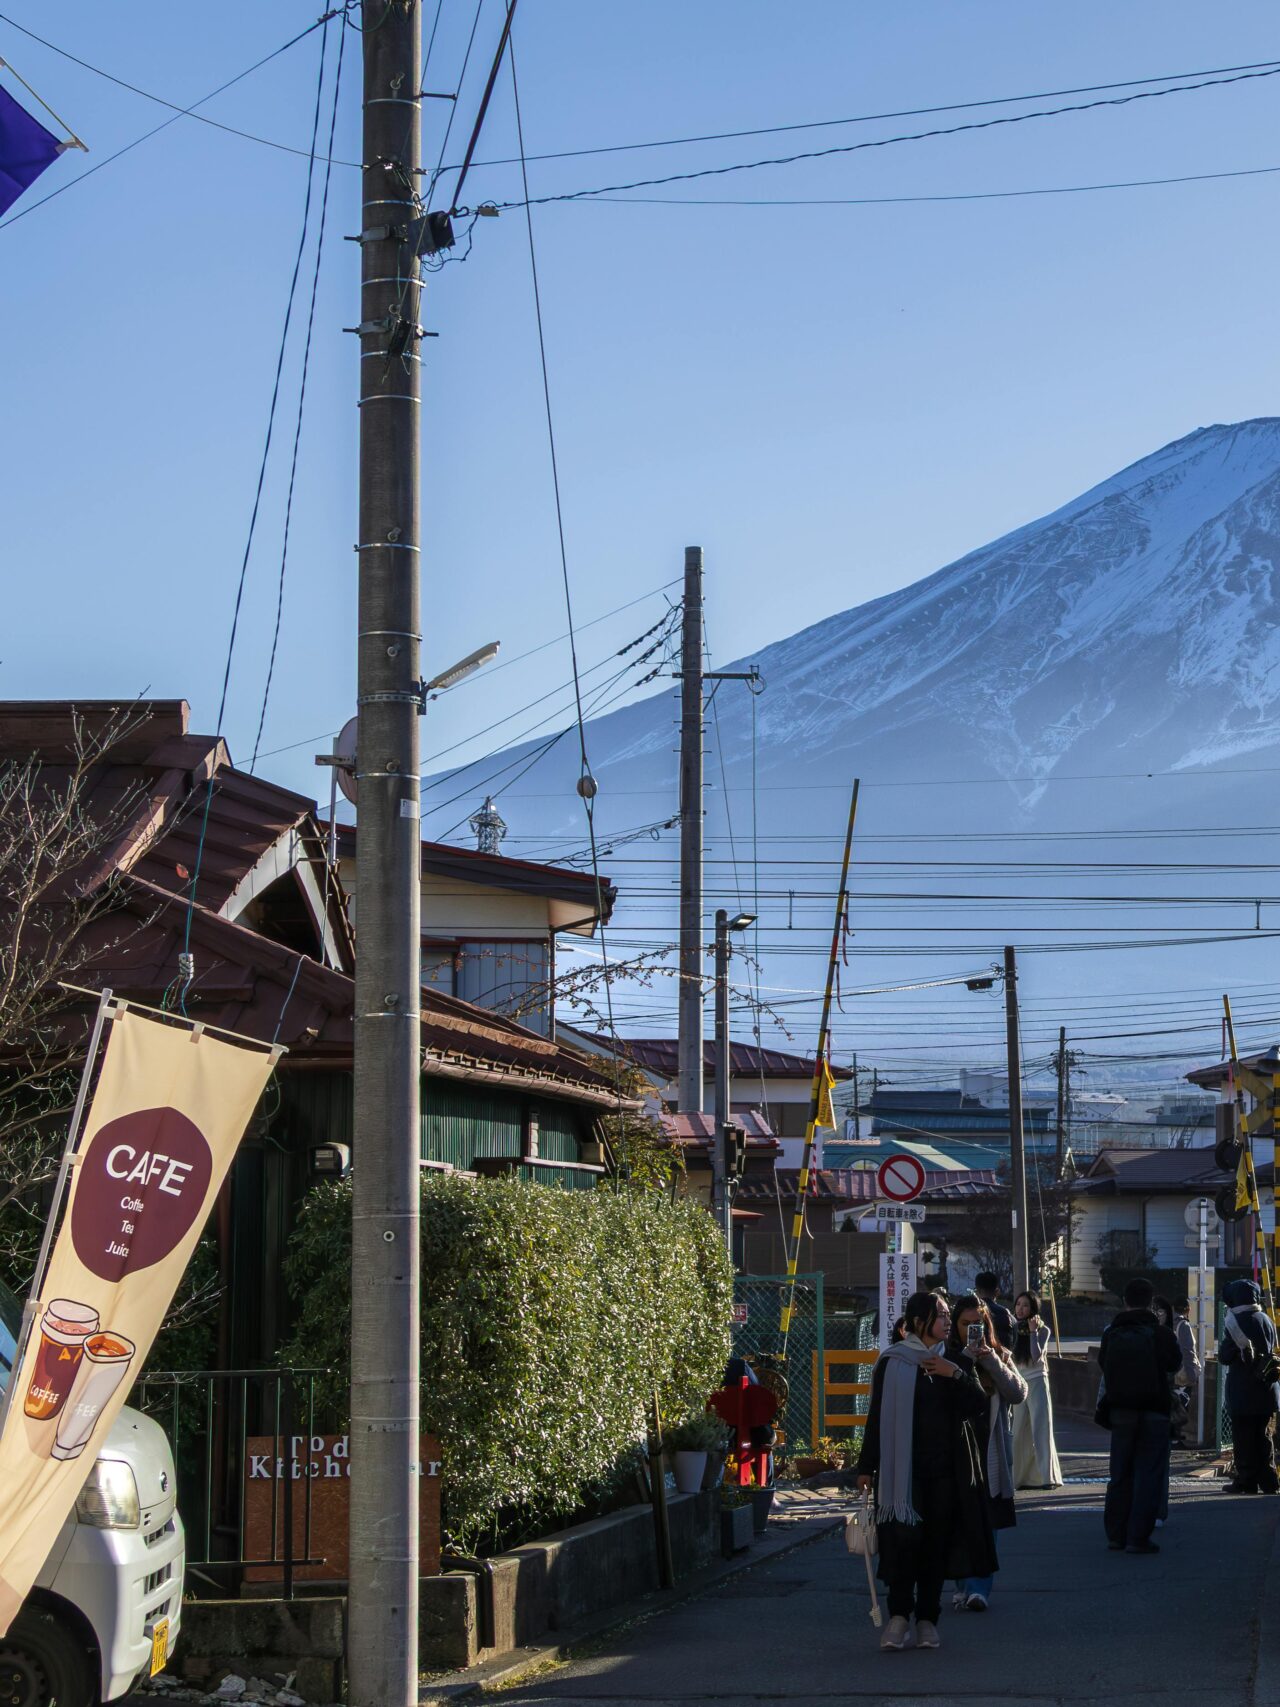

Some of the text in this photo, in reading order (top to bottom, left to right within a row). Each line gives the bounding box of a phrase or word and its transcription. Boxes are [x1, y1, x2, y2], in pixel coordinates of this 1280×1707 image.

[105, 1144, 193, 1196] CAFE
[879, 1207, 923, 1220] 自転車を除く
[121, 1220, 134, 1235] Tea
[30, 1384, 60, 1404] COFFEE
